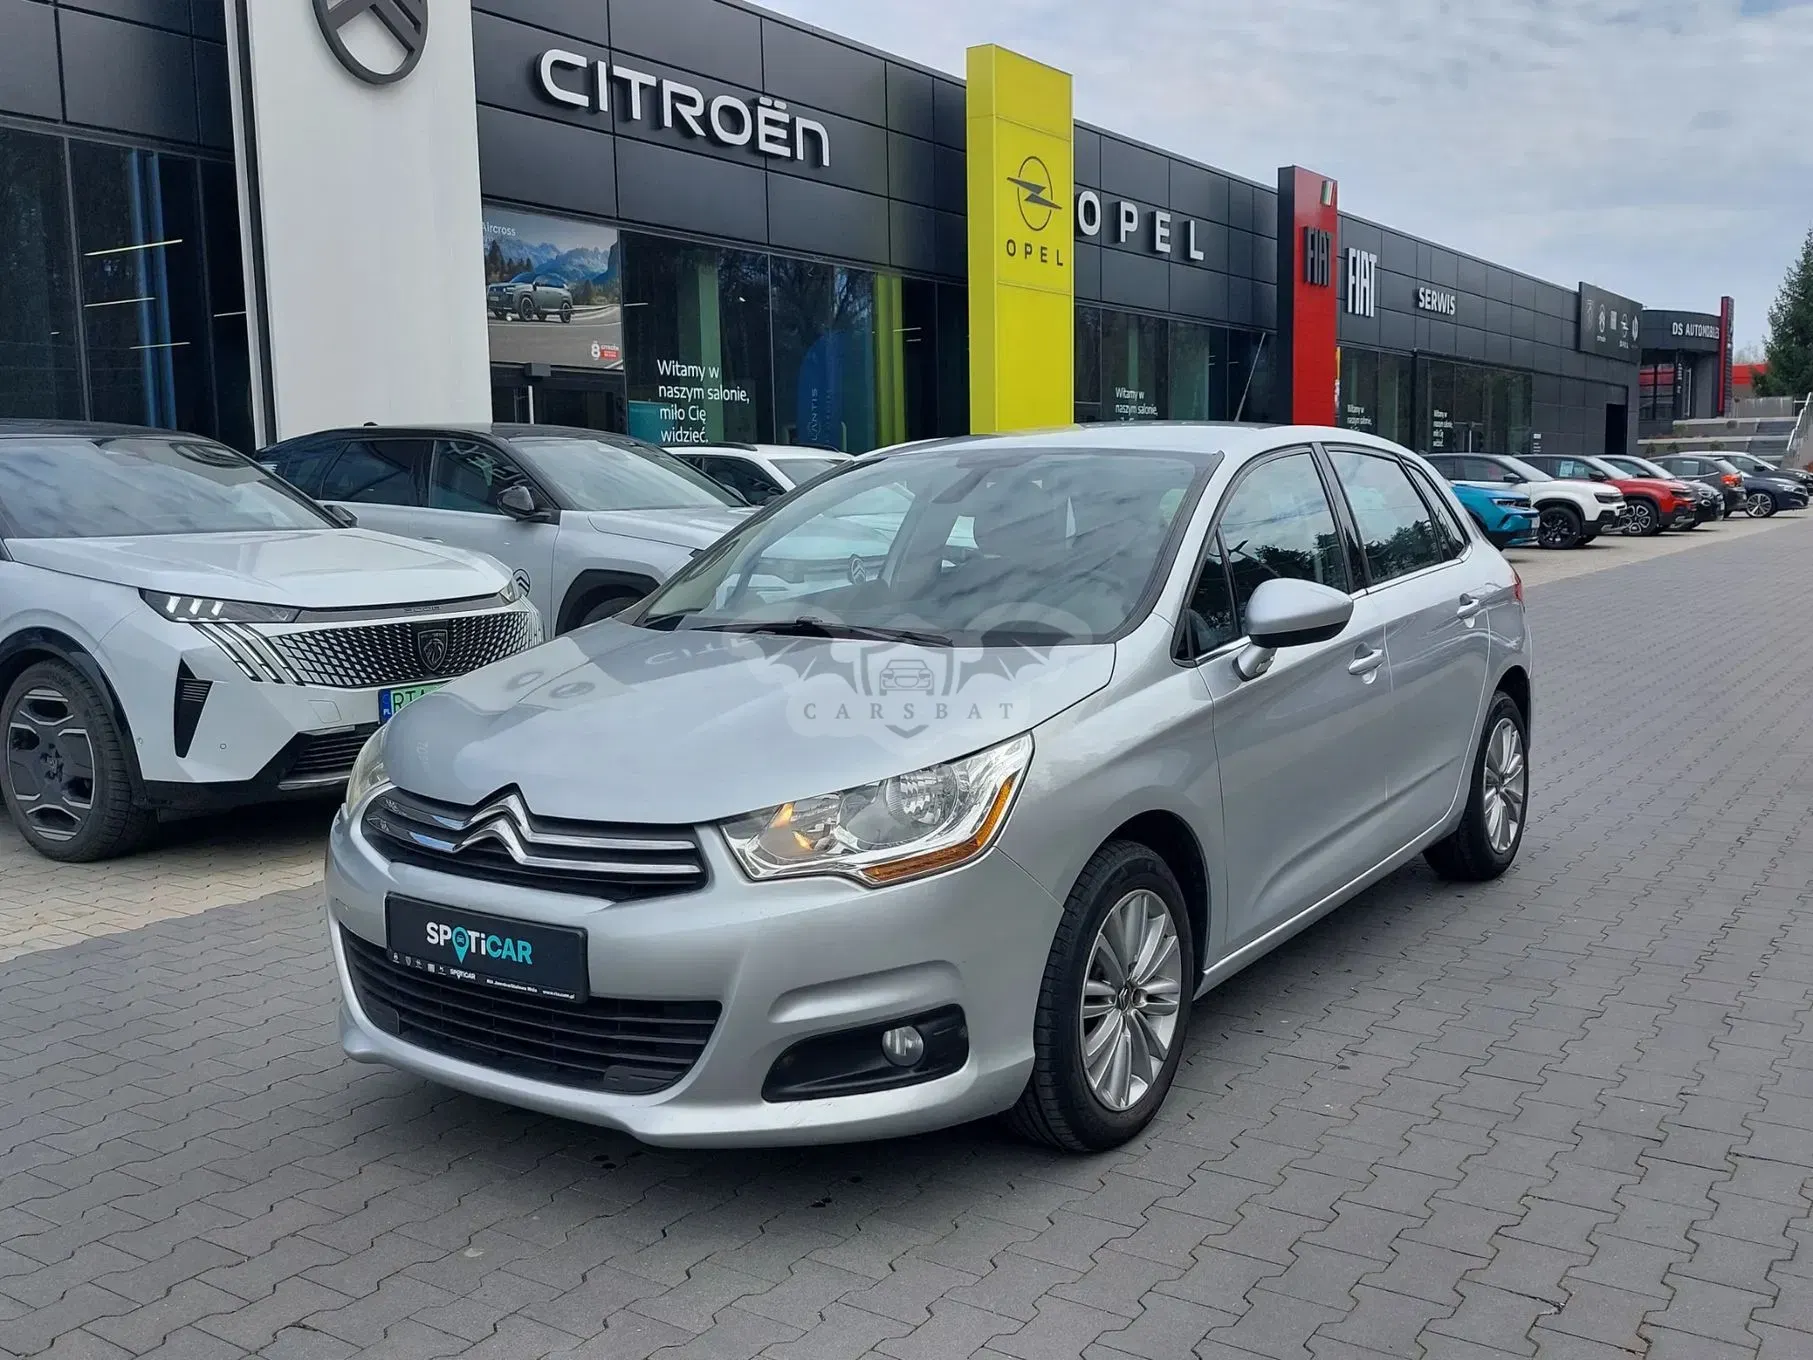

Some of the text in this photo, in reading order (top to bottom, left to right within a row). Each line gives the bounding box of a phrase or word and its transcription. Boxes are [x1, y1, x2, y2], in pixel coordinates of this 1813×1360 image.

[482, 222, 516, 237] Aircross
[1078, 190, 1205, 261] OPEL
[1006, 239, 1064, 267] OPEL
[1304, 226, 1333, 288] FIAT
[1347, 247, 1377, 318] FIAT
[1419, 287, 1456, 316] SERWIS
[1672, 322, 1684, 336] DS
[657, 359, 719, 382] Witamy w
[659, 384, 750, 404] naszym salonie,
[660, 403, 707, 425] miło Cię
[660, 426, 709, 443] widzieć.
